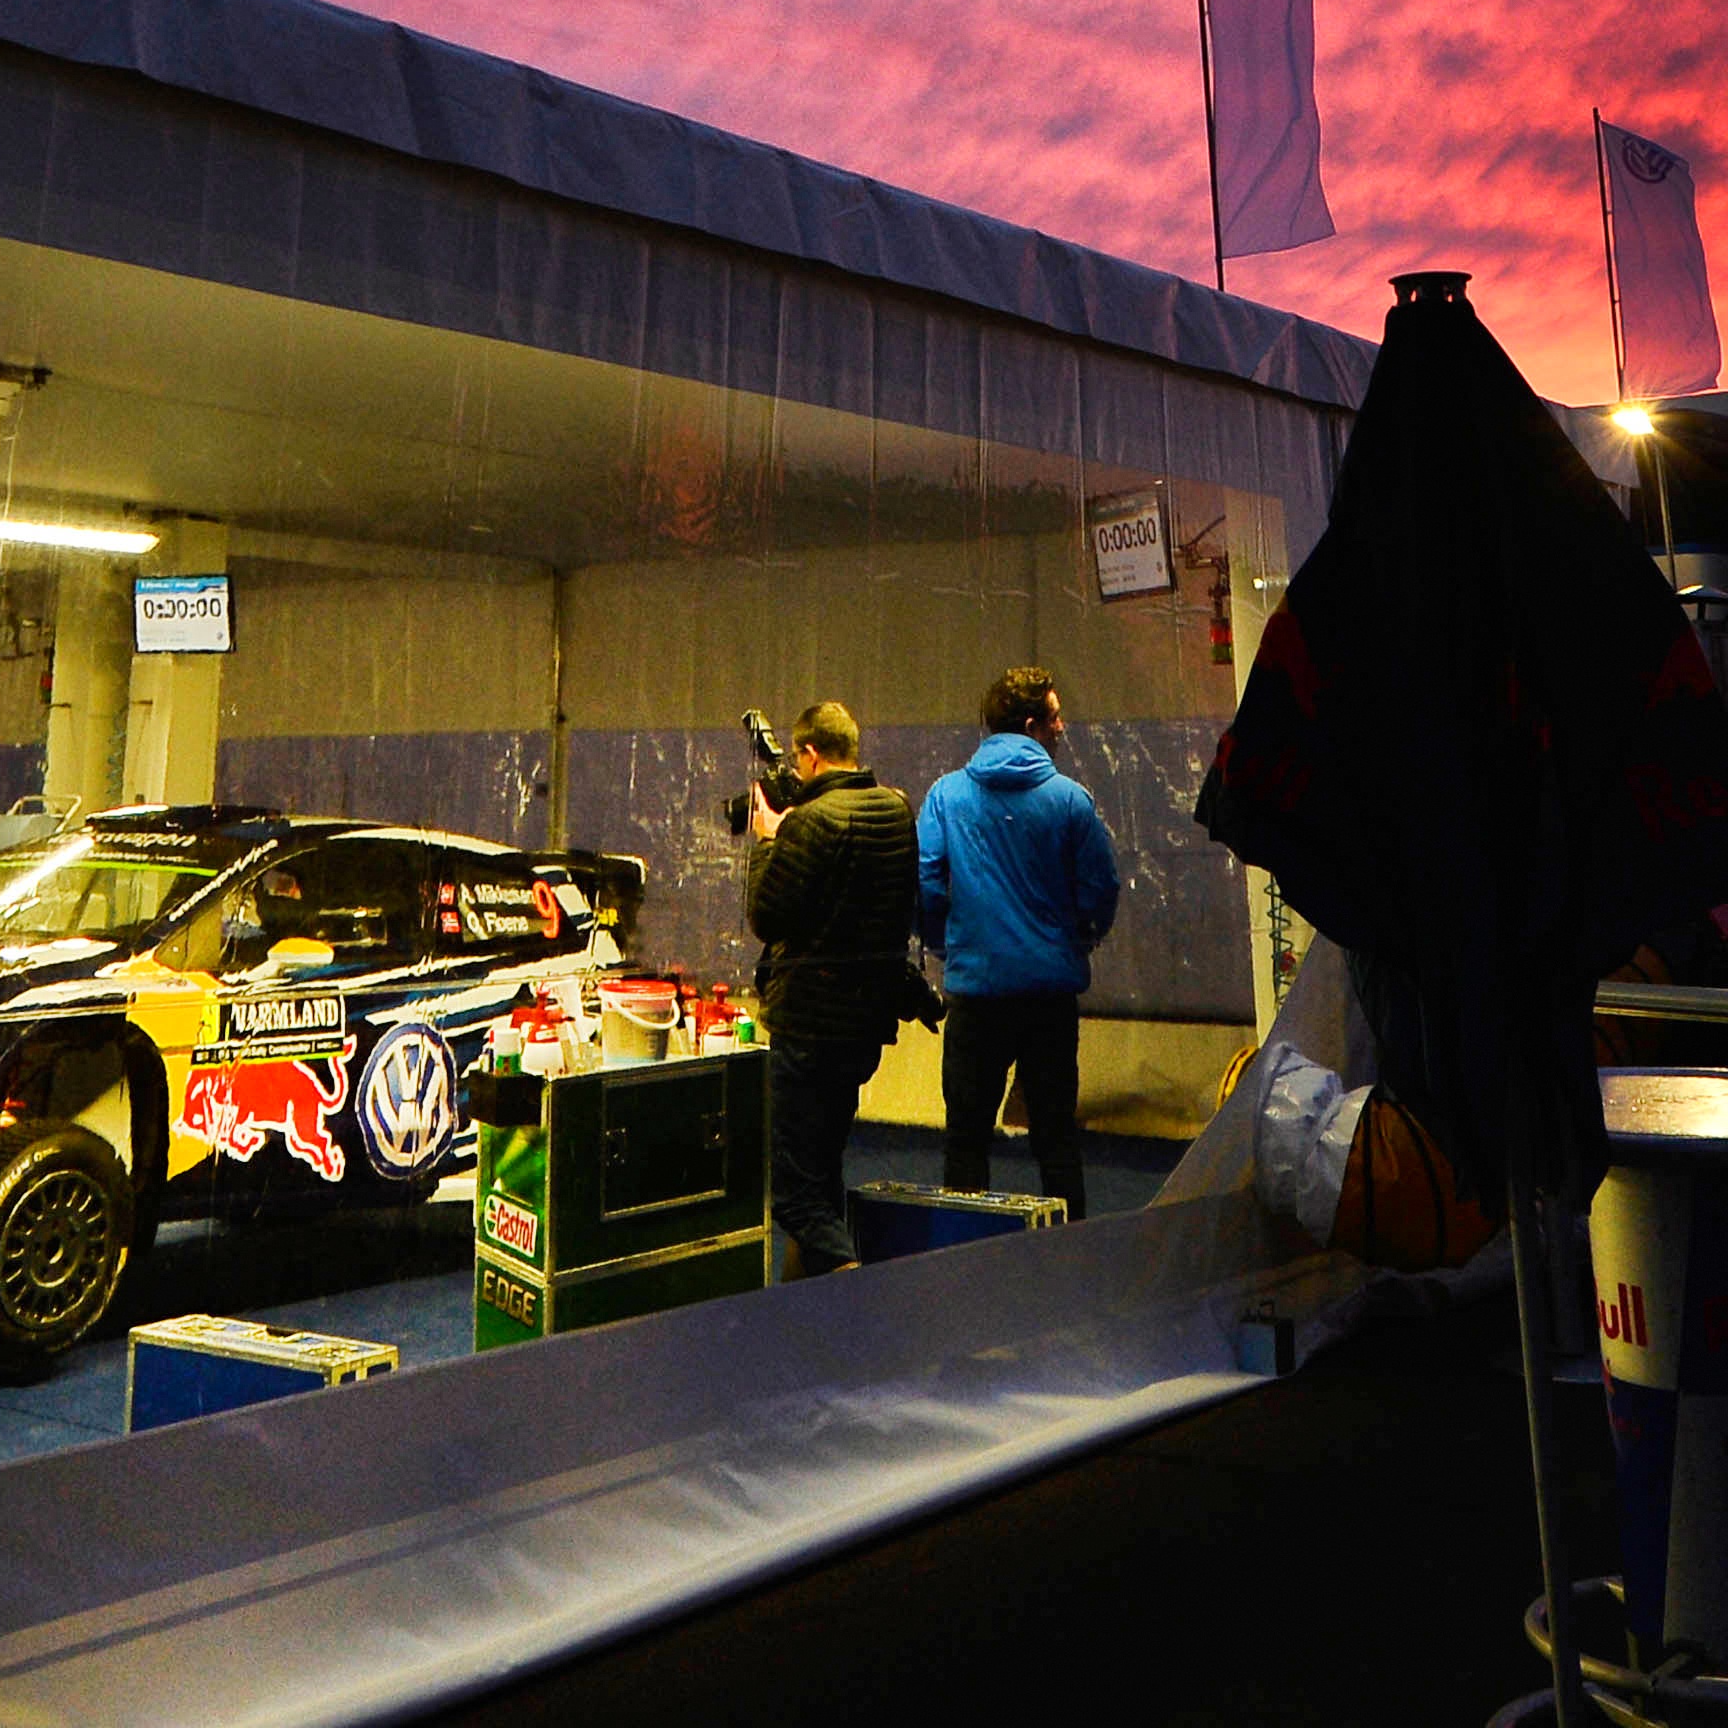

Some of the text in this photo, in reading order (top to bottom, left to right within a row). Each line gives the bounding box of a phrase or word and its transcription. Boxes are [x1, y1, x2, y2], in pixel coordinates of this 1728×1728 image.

[1099, 518, 1157, 553] 0:00:00
[533, 880, 560, 939] 9
[496, 1203, 535, 1253] Castrol
[482, 1269, 537, 1328] EDGE
[1596, 1282, 1647, 1347] ull
